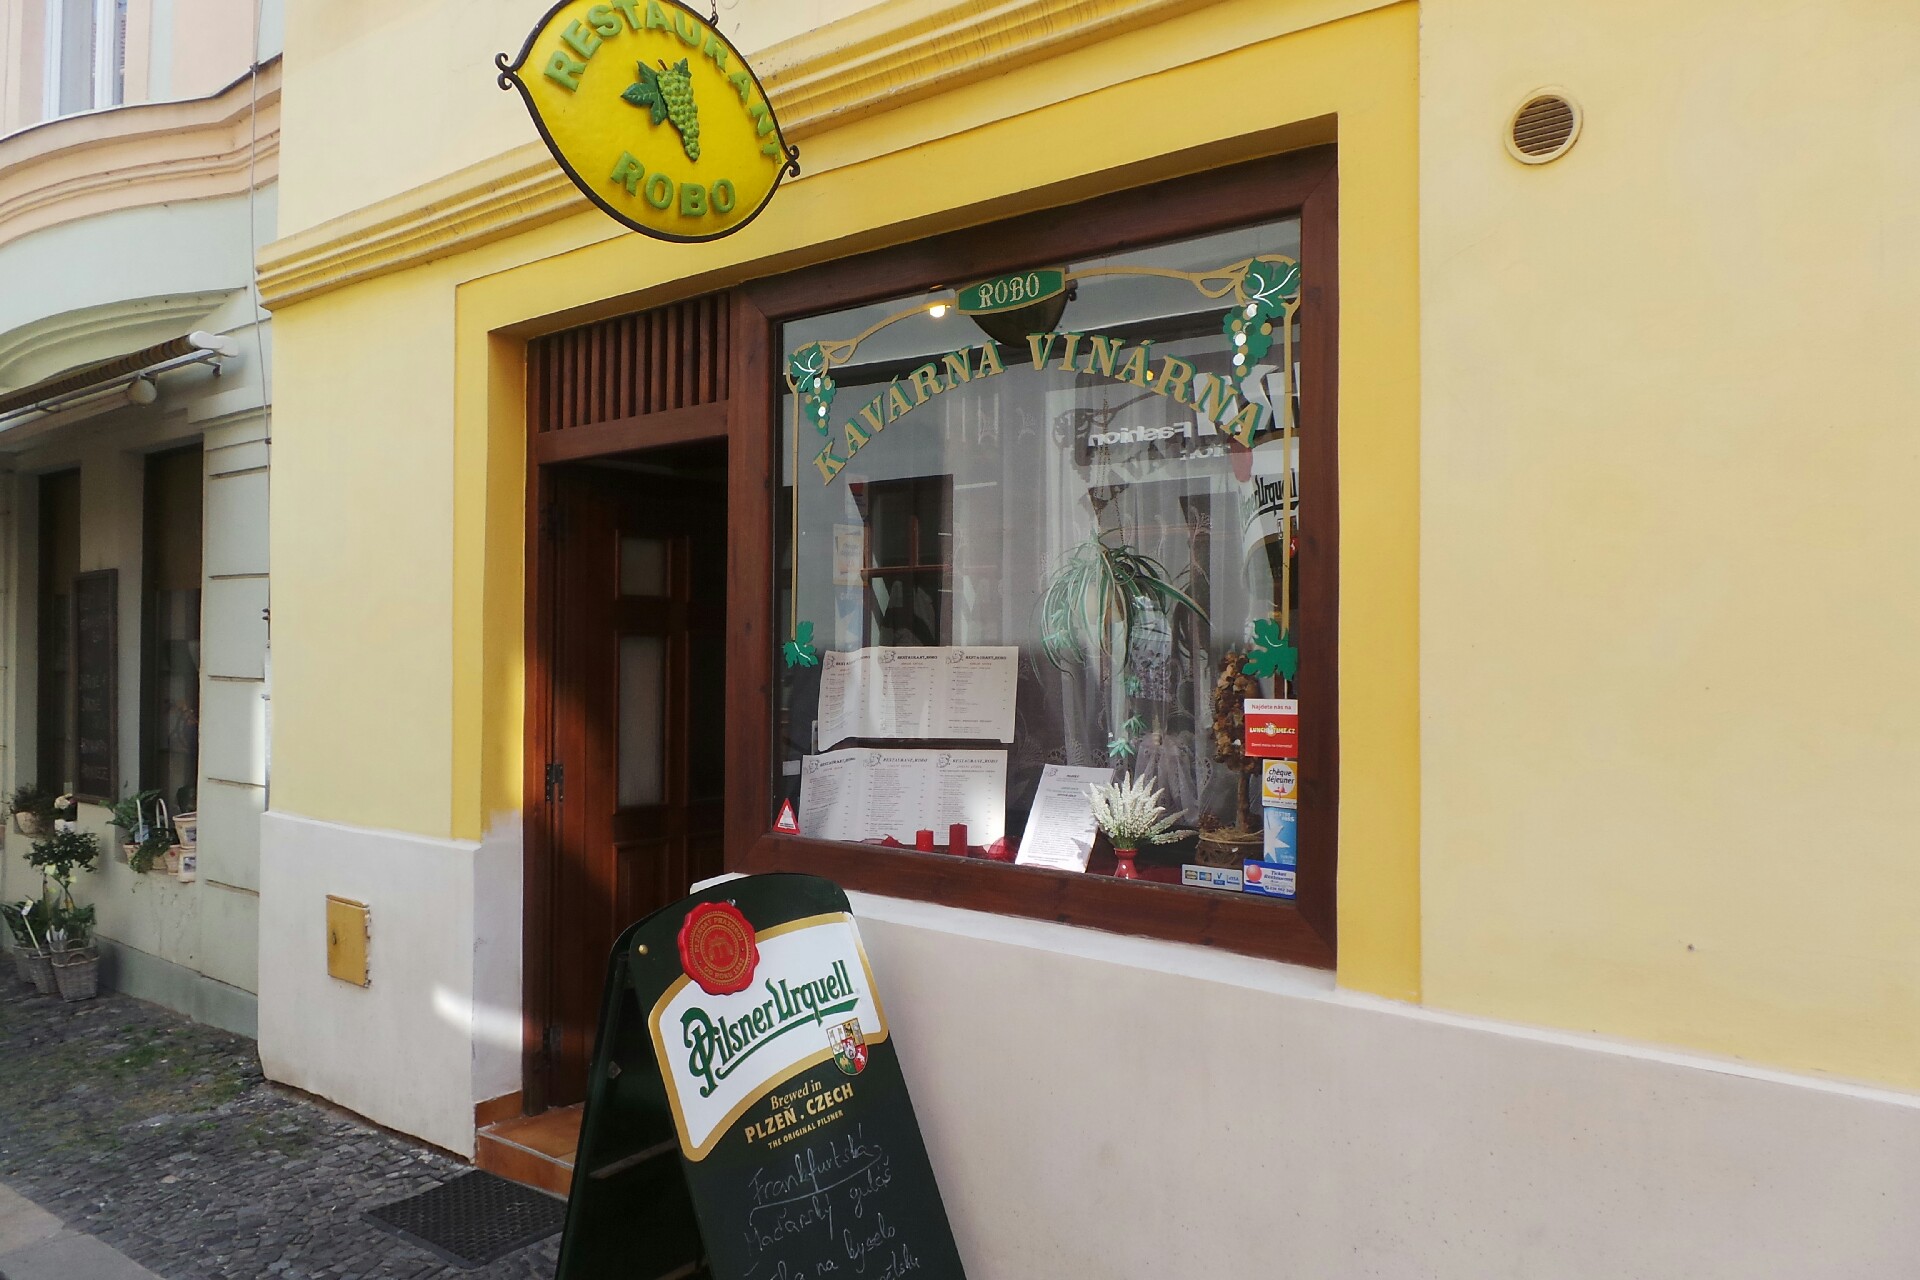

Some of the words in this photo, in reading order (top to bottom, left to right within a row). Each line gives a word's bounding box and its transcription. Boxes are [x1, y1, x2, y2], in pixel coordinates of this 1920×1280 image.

[544, 0, 783, 165] RESTAURANT
[610, 151, 736, 217] ROBO
[979, 272, 1041, 308] ROBO
[813, 339, 1008, 486] KAVÁRNA
[1026, 331, 1267, 449] VINÁRNA
[1266, 776, 1295, 784] déjeuner
[1268, 768, 1292, 777] chèque
[744, 1103, 798, 1144] PLZEŇ
[806, 1082, 854, 1116] CZECH
[770, 1082, 809, 1111] Brewed
[811, 1079, 822, 1093] in
[768, 1138, 782, 1150] THE
[783, 1122, 817, 1143] ORIGINAL
[817, 1109, 844, 1127] PILSNER
[816, 1259, 839, 1276] na
